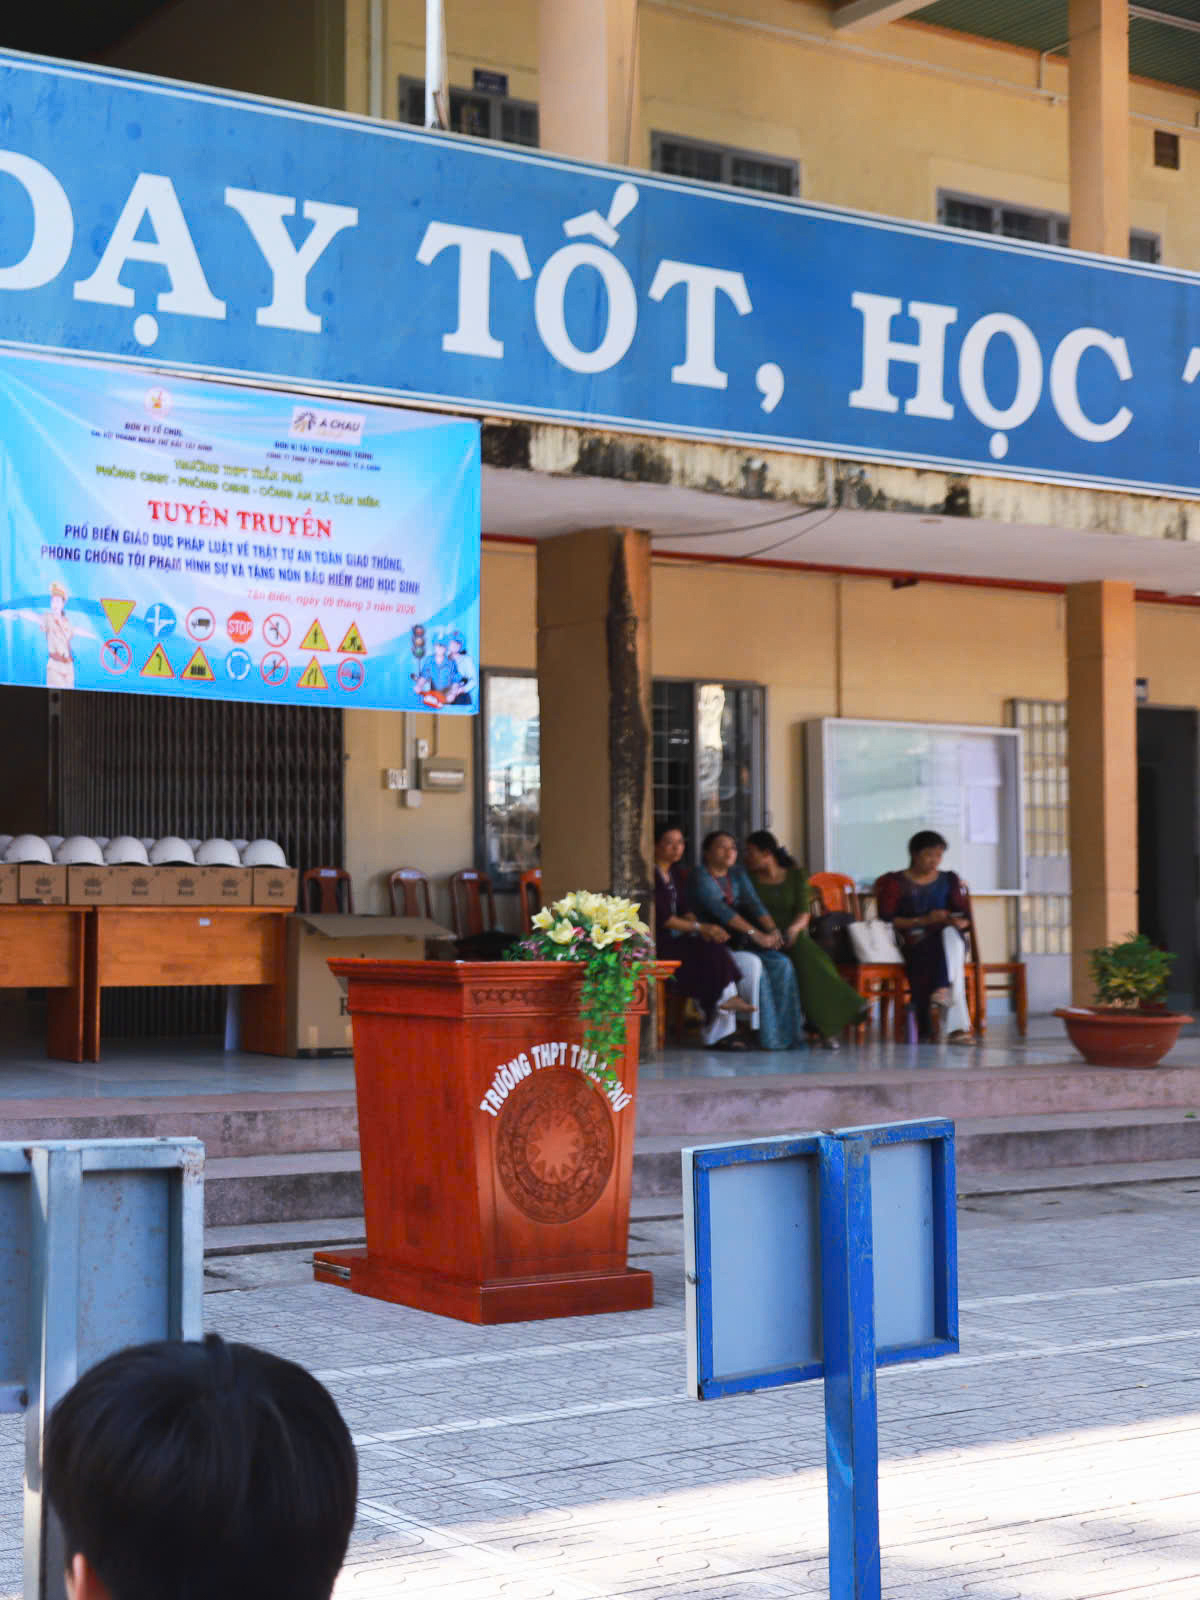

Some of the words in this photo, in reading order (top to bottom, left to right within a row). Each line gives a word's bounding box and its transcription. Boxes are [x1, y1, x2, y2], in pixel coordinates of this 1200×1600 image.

[416, 183, 784, 413] TỐT,
[849, 292, 1133, 459] HỌC
[147, 500, 229, 527] TUYÊN
[85, 546, 124, 566] CHỐNG
[128, 551, 145, 570] TỘI
[149, 555, 181, 573] PHẠM
[356, 575, 374, 588] CHO
[378, 576, 396, 594] HỌC
[123, 529, 148, 546] GIÁO
[153, 533, 174, 550] DỤC
[177, 535, 205, 552] PHÁP
[208, 538, 233, 557] LUẬT
[253, 542, 278, 562] TRẬT
[297, 550, 311, 562] AN
[346, 553, 369, 568] GIAO
[229, 620, 251, 634] STOP
[480, 1053, 532, 1117] TRƯỜNG
[531, 1042, 568, 1070] THPT
